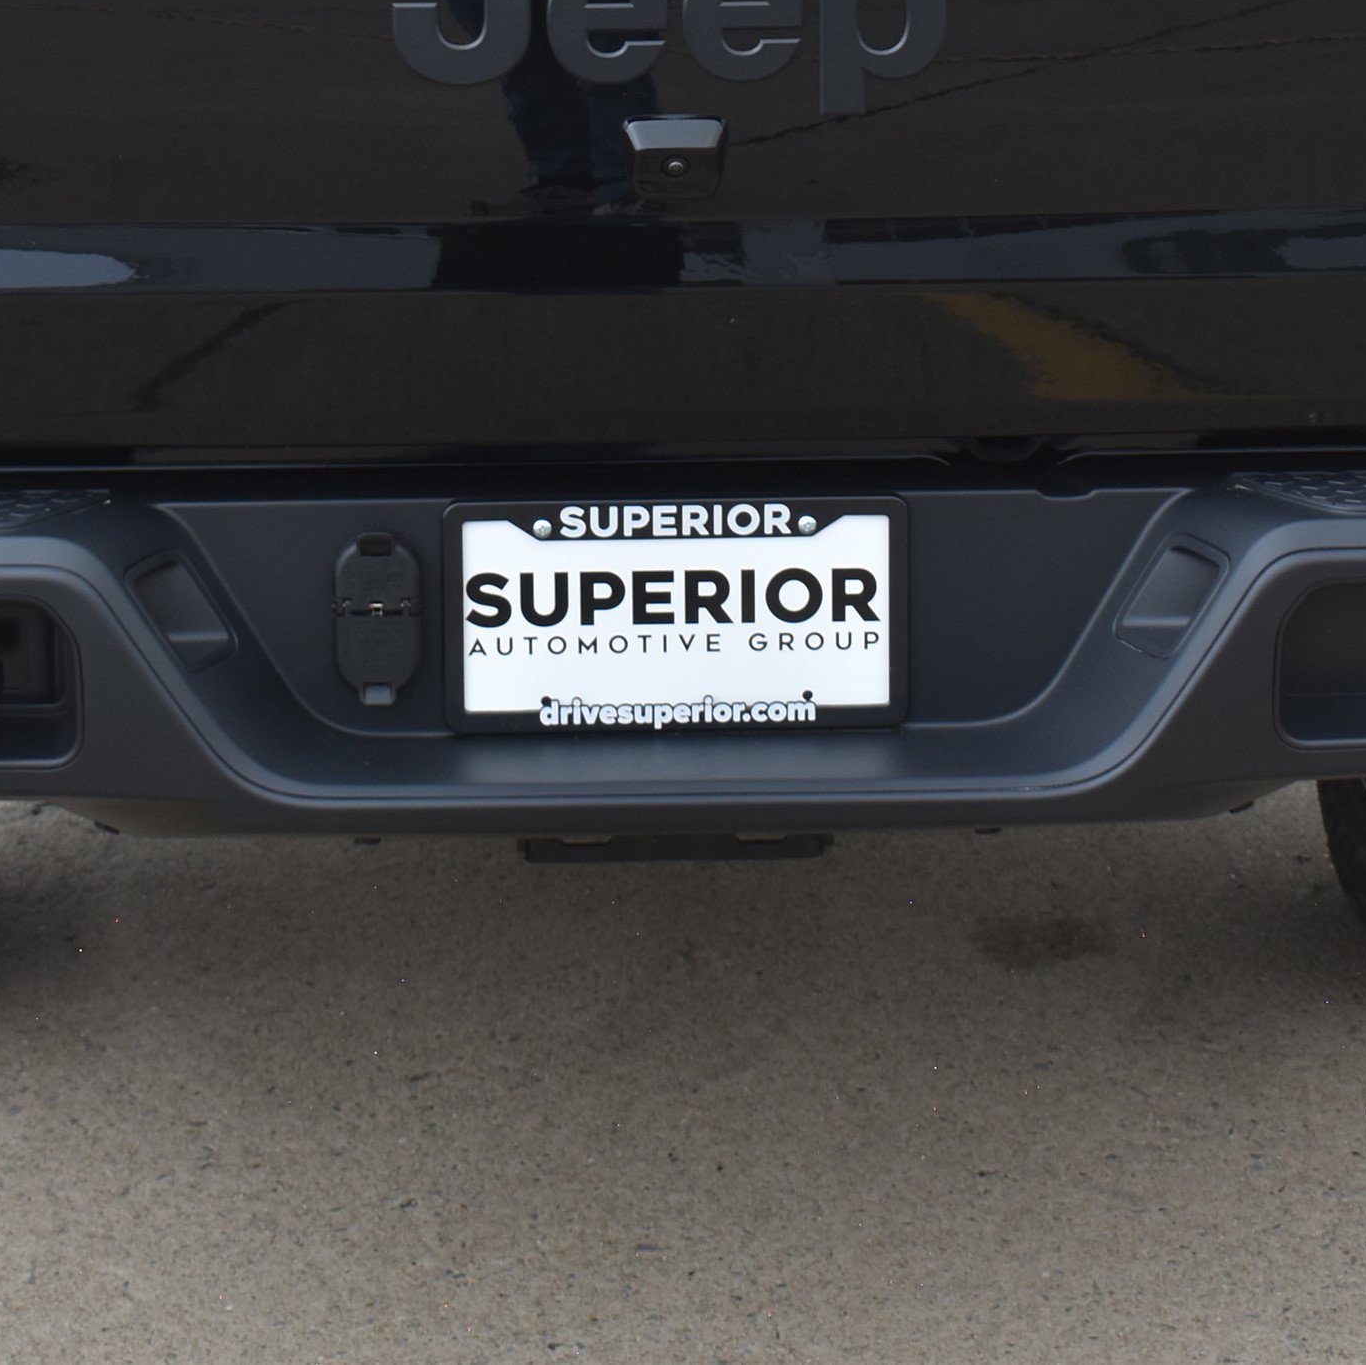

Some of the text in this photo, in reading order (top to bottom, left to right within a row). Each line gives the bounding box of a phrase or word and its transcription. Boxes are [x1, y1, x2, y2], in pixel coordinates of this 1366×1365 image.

[559, 503, 792, 538] SUPERIOR
[465, 567, 880, 628] SUPERIOR
[468, 631, 881, 656] AUTOMOTIVE GROUP
[539, 695, 816, 730] drivesuperior.com
